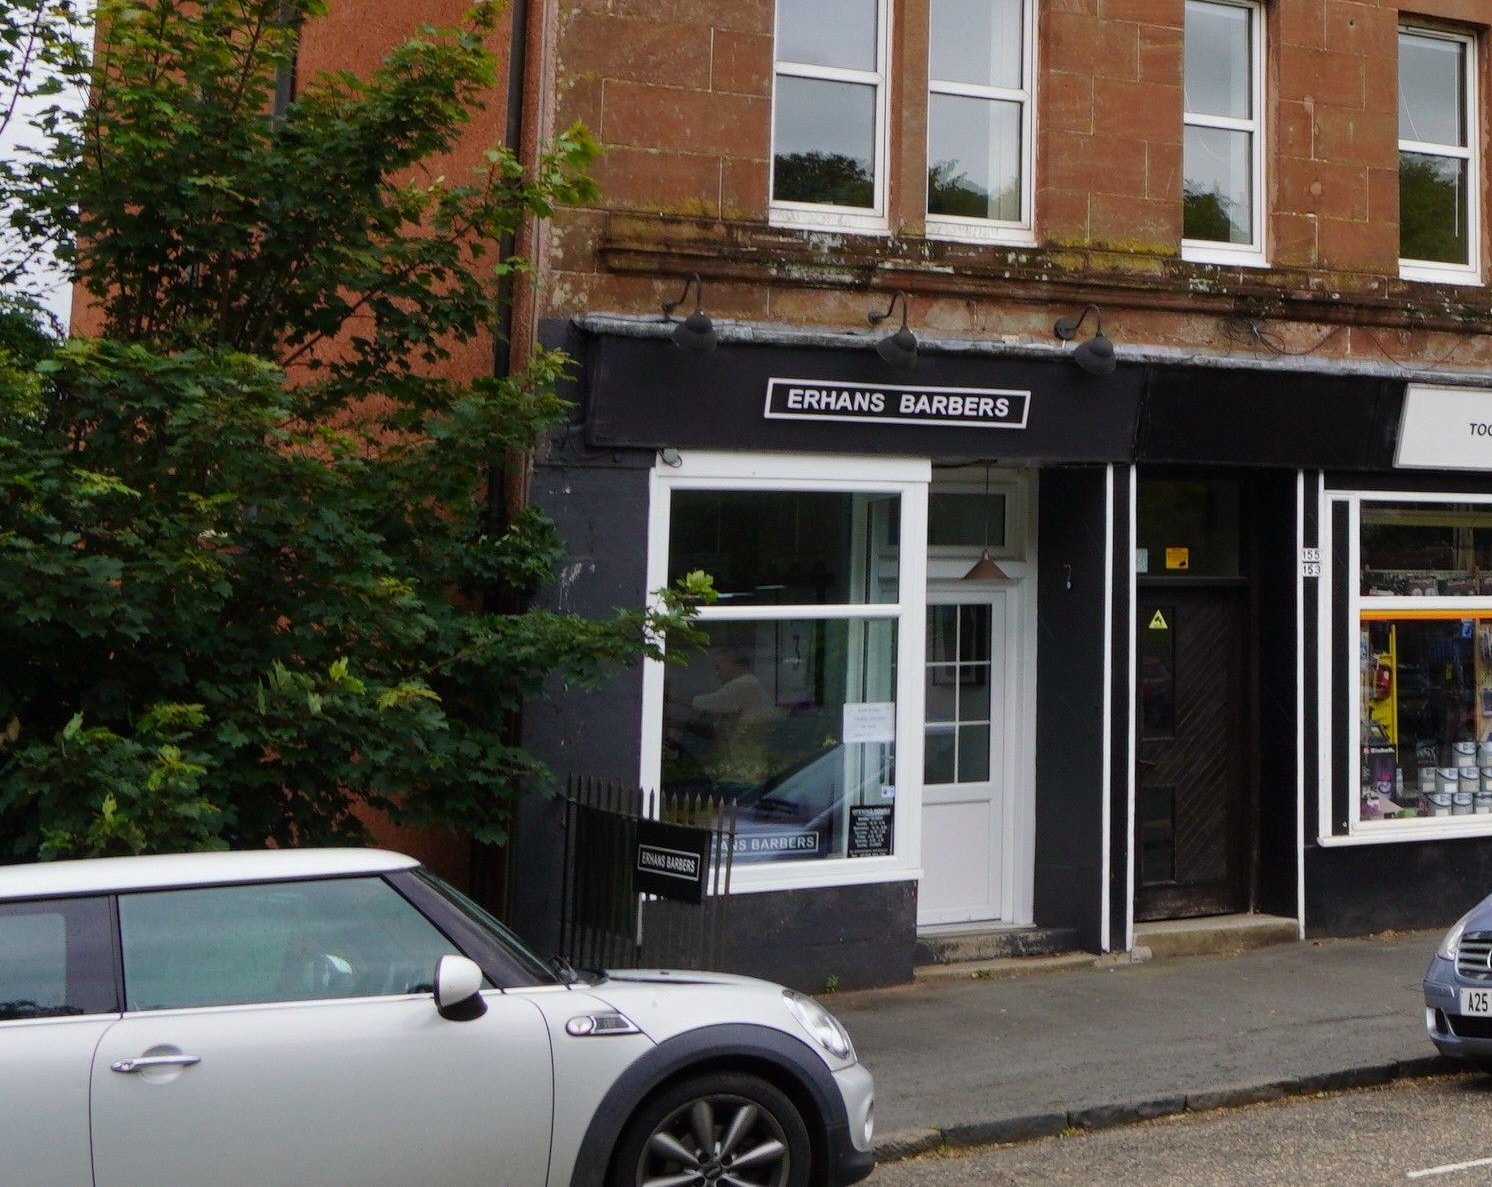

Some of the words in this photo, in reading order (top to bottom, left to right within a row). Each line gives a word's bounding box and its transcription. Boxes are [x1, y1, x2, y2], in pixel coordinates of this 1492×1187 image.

[787, 389, 885, 412] ERHANS
[900, 394, 1009, 417] BARBERS
[751, 836, 814, 851] BARBERS
[642, 851, 665, 868] ERHANS
[666, 856, 695, 873] BARBERS
[1468, 992, 1488, 1013] A25
